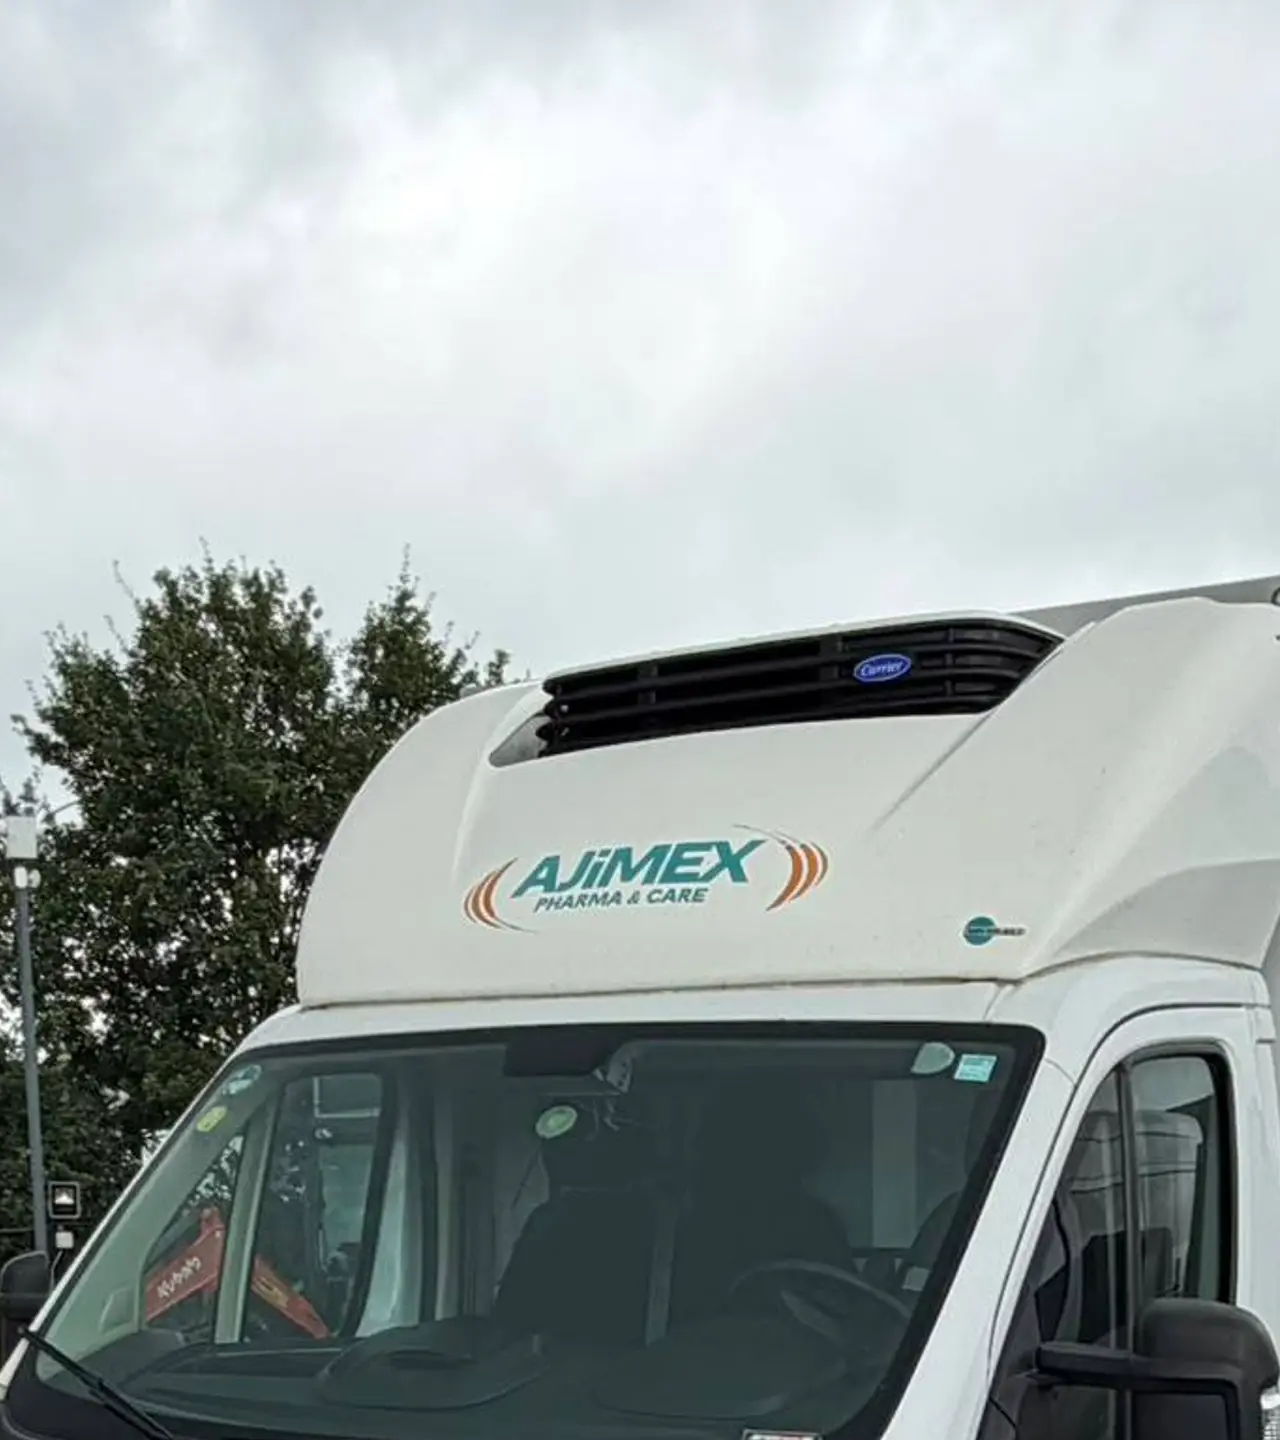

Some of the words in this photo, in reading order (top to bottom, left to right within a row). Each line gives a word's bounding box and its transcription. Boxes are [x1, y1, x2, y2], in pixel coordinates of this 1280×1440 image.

[533, 891, 622, 913] PHARMA
[626, 890, 640, 906] &
[646, 887, 708, 904] CARE
